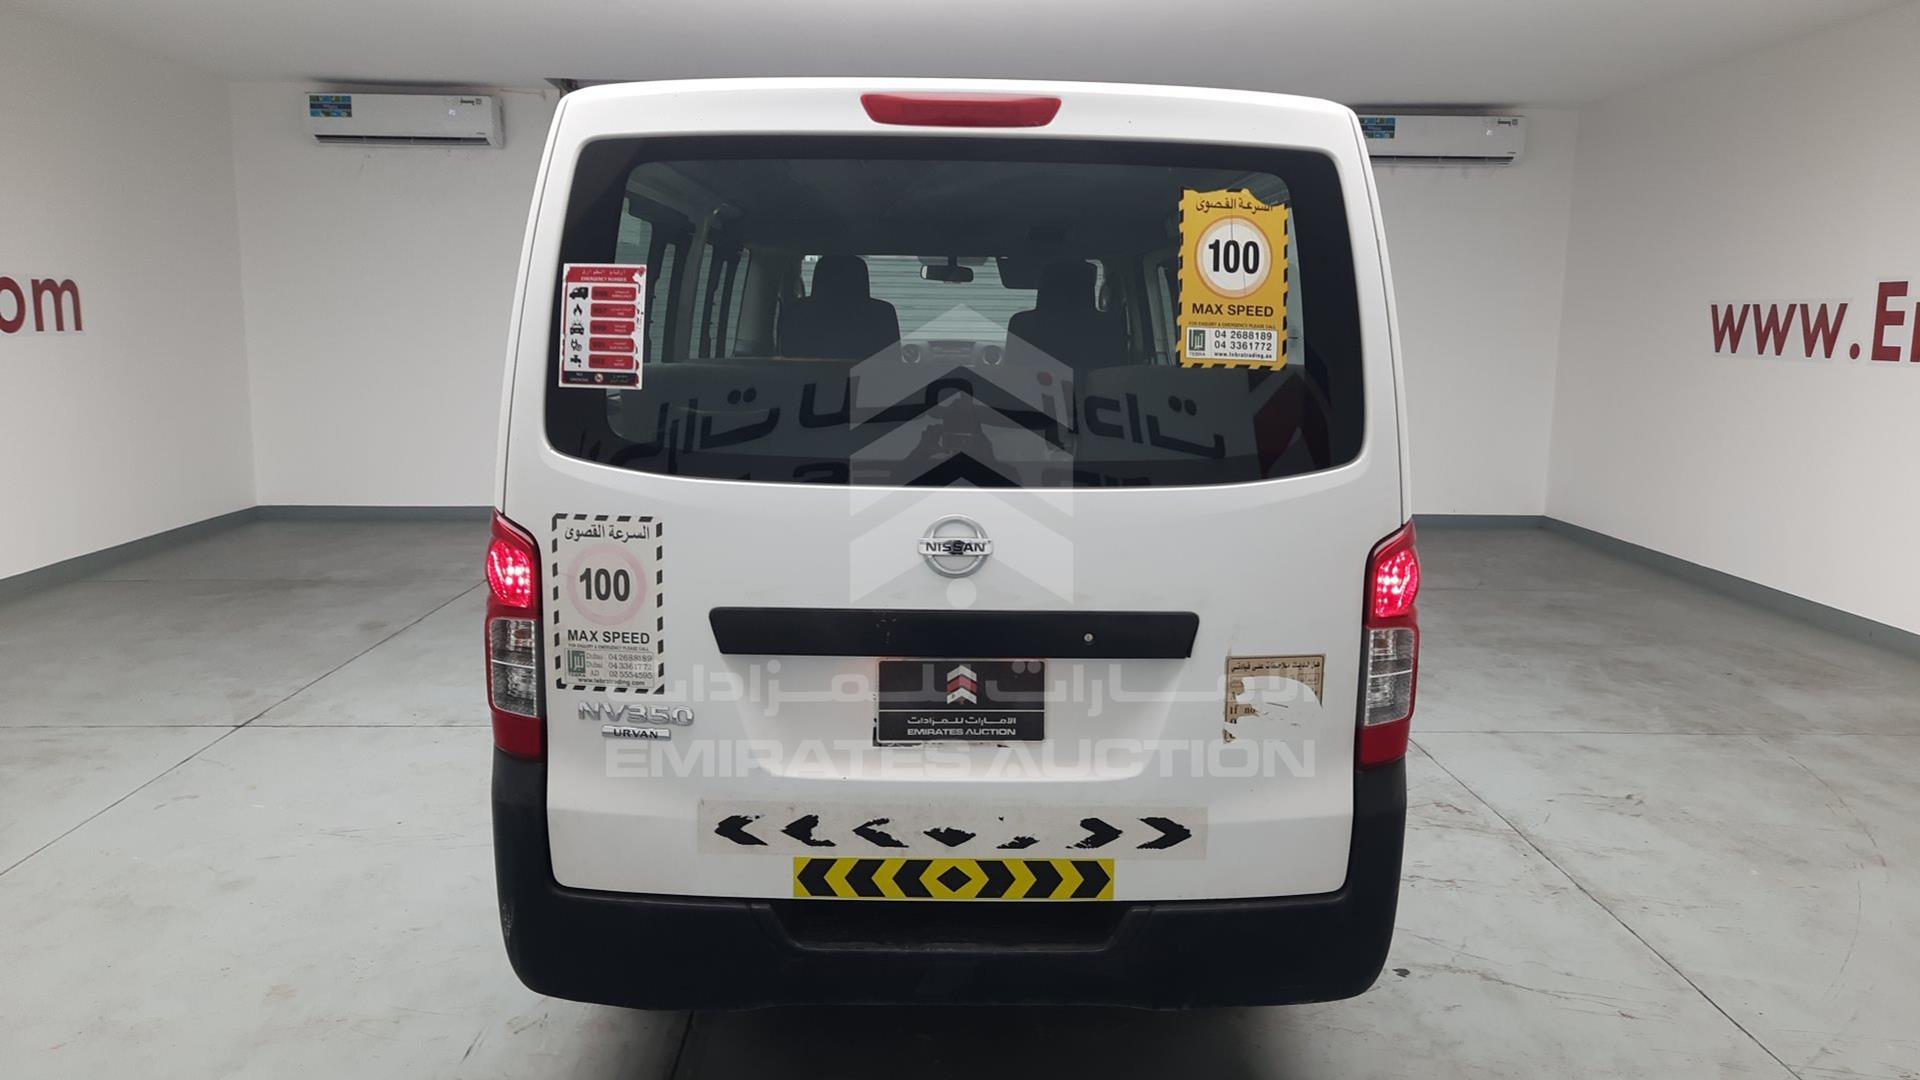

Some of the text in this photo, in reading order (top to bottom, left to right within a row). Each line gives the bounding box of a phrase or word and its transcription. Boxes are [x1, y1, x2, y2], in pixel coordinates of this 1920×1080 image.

[1196, 197, 1237, 213] القصوى
[1208, 239, 1261, 275] 100
[1192, 303, 1274, 317] MAX SPEED
[1711, 281, 1920, 362] www.E
[1214, 330, 1272, 340] 04 2688189
[1214, 340, 1272, 351] 04 3361772
[565, 524, 650, 543] السرعة القصوى
[926, 542, 985, 552] NISSAN
[579, 567, 631, 602] 100
[567, 630, 650, 644] MAX SPEED
[578, 701, 695, 726] NV350
[907, 716, 1016, 726] الامارات للمزادات
[613, 728, 658, 739] URVAN
[907, 728, 1016, 736] EMIRATES AUCTION
